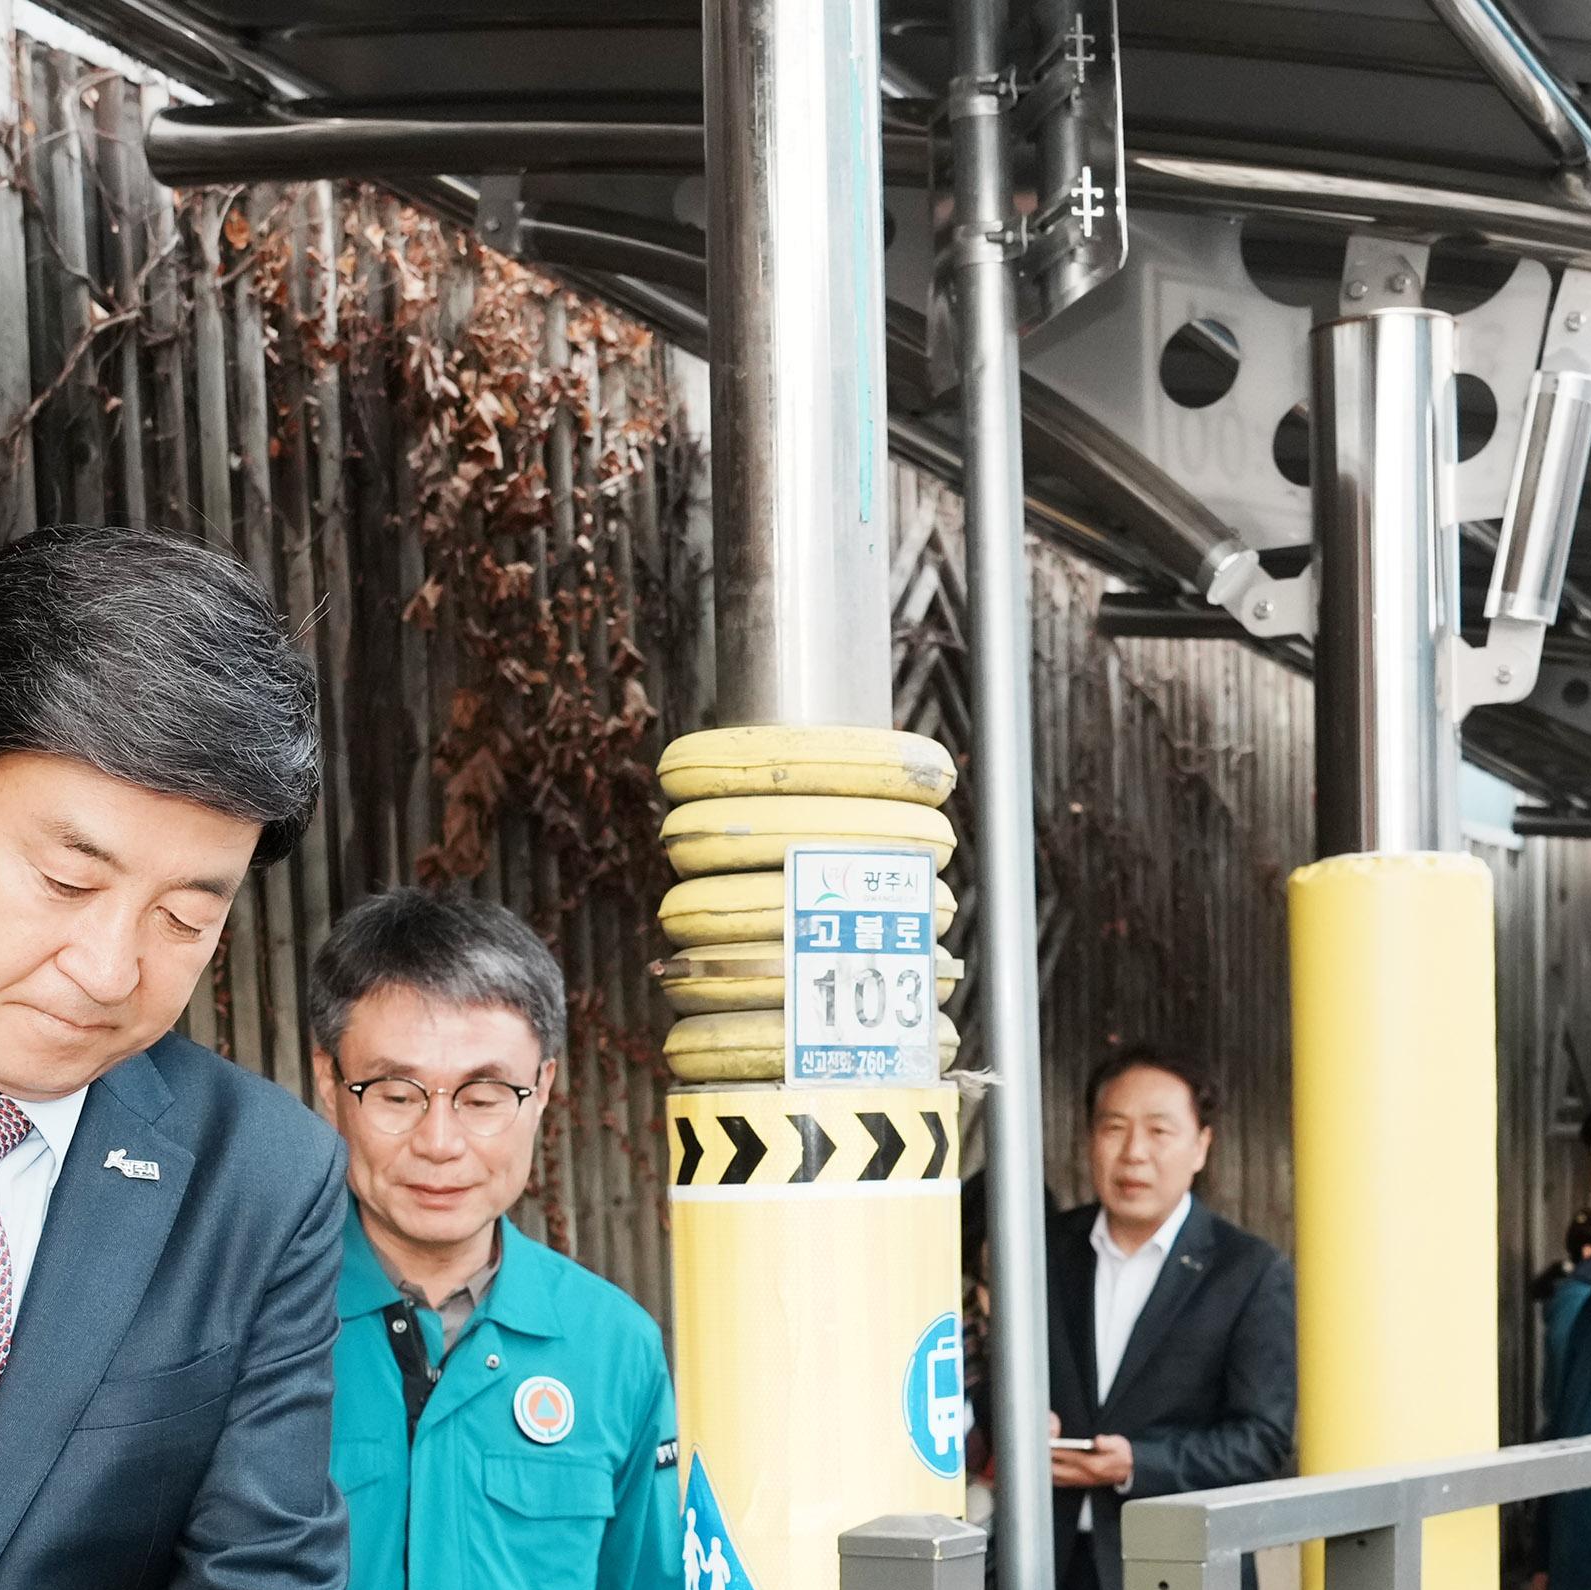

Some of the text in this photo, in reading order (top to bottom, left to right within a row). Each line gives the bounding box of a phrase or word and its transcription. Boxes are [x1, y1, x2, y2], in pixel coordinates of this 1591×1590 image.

[863, 871, 919, 894] 광주시
[809, 914, 922, 950] 고불로
[812, 968, 923, 1029] 103
